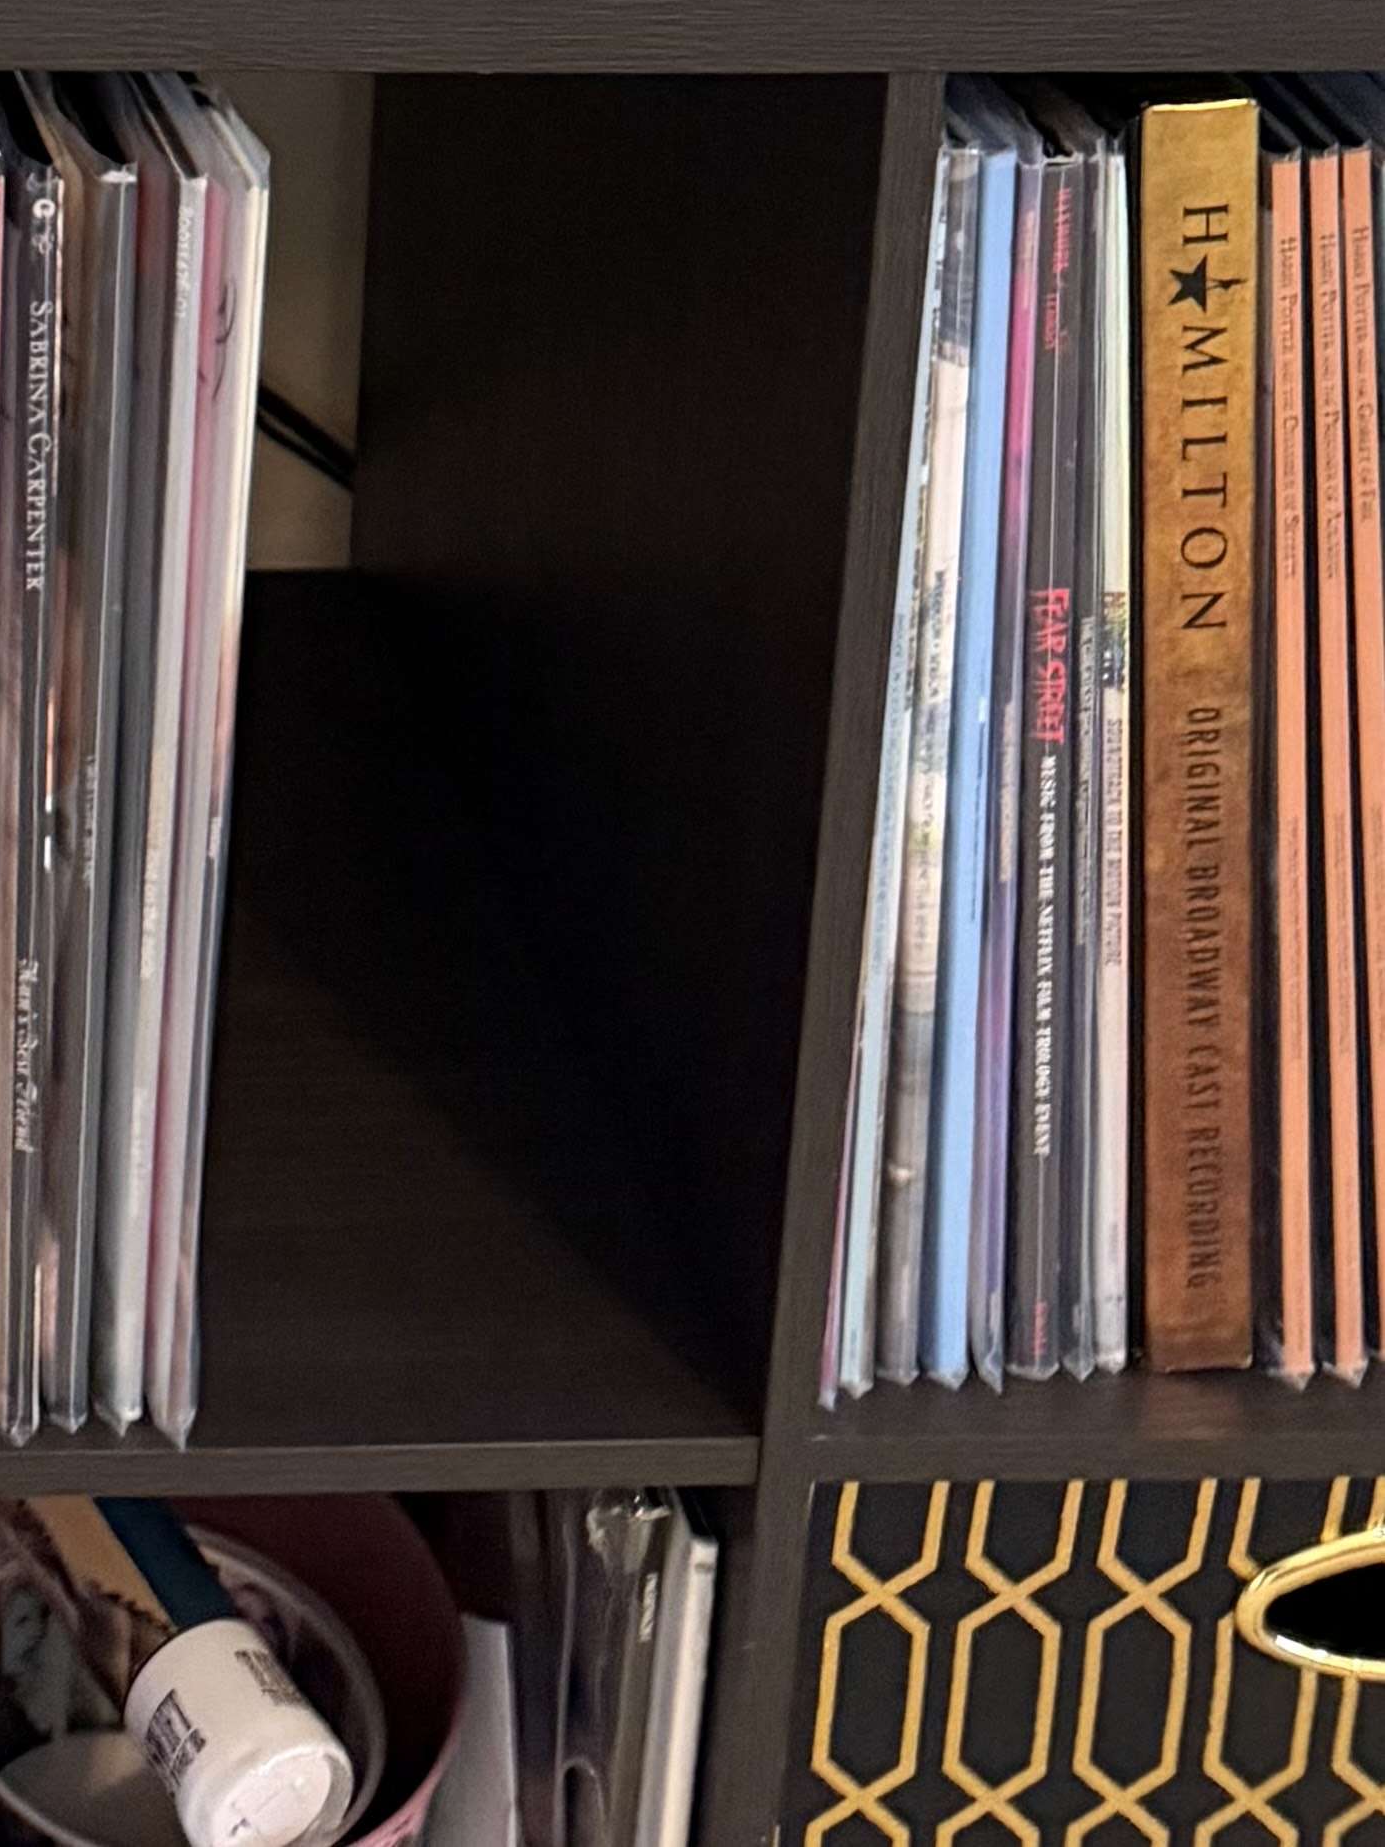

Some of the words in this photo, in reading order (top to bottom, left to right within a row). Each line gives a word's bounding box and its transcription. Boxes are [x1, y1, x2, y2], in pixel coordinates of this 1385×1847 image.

[27, 300, 54, 426] SABRINA
[25, 433, 52, 591] CARPENTER
[1033, 588, 1070, 652] FEAR
[1030, 660, 1068, 746] STREET
[1040, 755, 1058, 807] MUSIC
[1184, 707, 1222, 850] ORIGINAL
[1039, 813, 1057, 860] FROM
[1039, 865, 1055, 902] THE
[1037, 906, 1055, 976] NETFLIX
[1185, 865, 1222, 1030] BROADWAY
[17, 959, 40, 1025] Man's
[1036, 980, 1053, 1020] FILM
[16, 1029, 38, 1076] Best
[1035, 1026, 1053, 1100] TRILOGY
[1184, 1044, 1221, 1109] CAST
[14, 1081, 38, 1154] Friend
[1184, 1126, 1221, 1290] RECORDING
